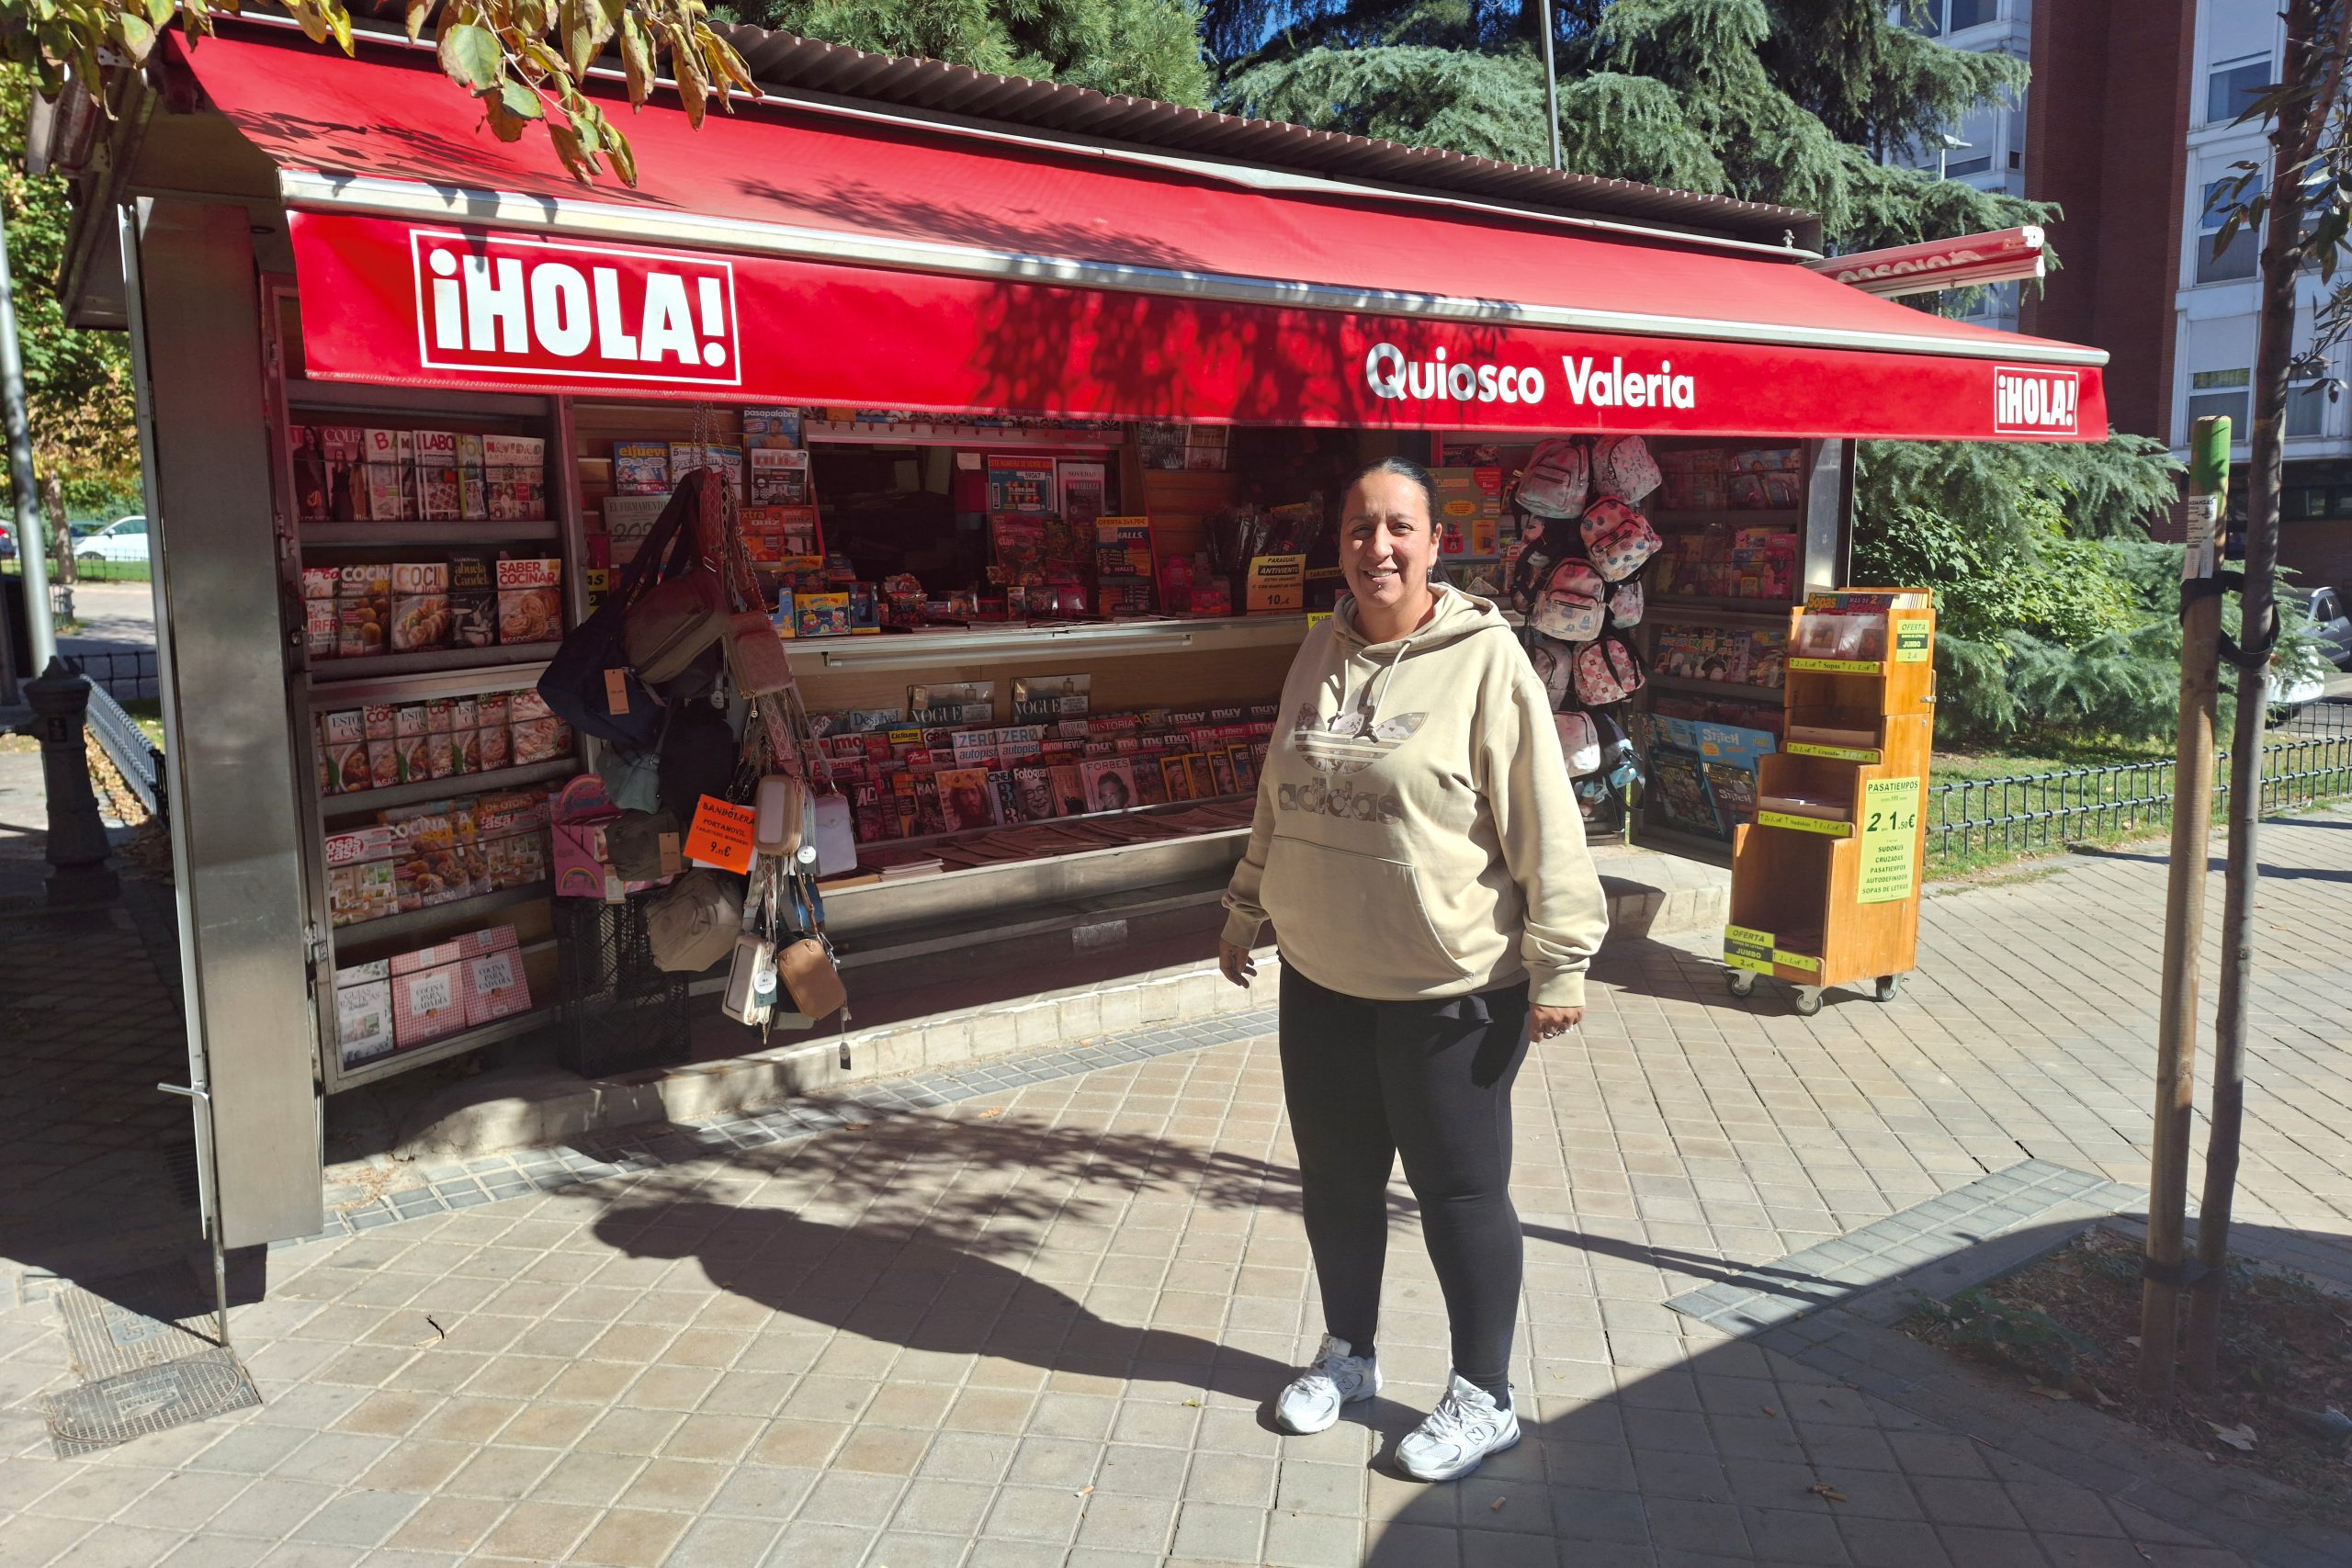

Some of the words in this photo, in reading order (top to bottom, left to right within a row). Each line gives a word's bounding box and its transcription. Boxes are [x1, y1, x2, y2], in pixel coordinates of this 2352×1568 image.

[429, 249, 727, 367] ¡HOLA!
[1366, 343, 1544, 404] Quiosco
[1562, 355, 1695, 409] Valeria
[1998, 375, 2076, 426] ¡HOLA!
[744, 409, 798, 419] pasapalabra
[499, 562, 541, 574] SABER
[1260, 567, 1299, 575] ANTIVIENTO
[499, 572, 556, 585] COCINAR
[1808, 592, 1838, 610] Sopas
[1870, 594, 1879, 604] 2
[1902, 623, 1926, 631] OFERTA
[1824, 661, 1840, 670] Sopas
[1015, 698, 1060, 716] VOGUE
[1211, 707, 1241, 718] muy
[1250, 705, 1278, 716] muy
[911, 705, 962, 723] VOGUE
[1176, 712, 1205, 723] muy
[1089, 719, 1134, 733] HISTORIA
[1042, 741, 1064, 751] AVION
[1087, 760, 1129, 772] FORBES
[1868, 780, 1918, 792] PASATIEMPOS
[1277, 777, 1403, 826] adidas
[702, 802, 755, 825] BANDOLERA
[703, 818, 746, 837] PORTAMOVIL
[1867, 812, 1882, 832] 2
[1878, 844, 1904, 852] SUDOKUS
[1875, 855, 1904, 863] CRUZADAS
[1870, 864, 1906, 874] PASATIEMPOS
[1866, 874, 1908, 884] AUTODEFINIDOS
[1862, 886, 1882, 895] SOPAS
[1733, 929, 1765, 942] OFERTA
[1736, 948, 1761, 959] JUMBO
